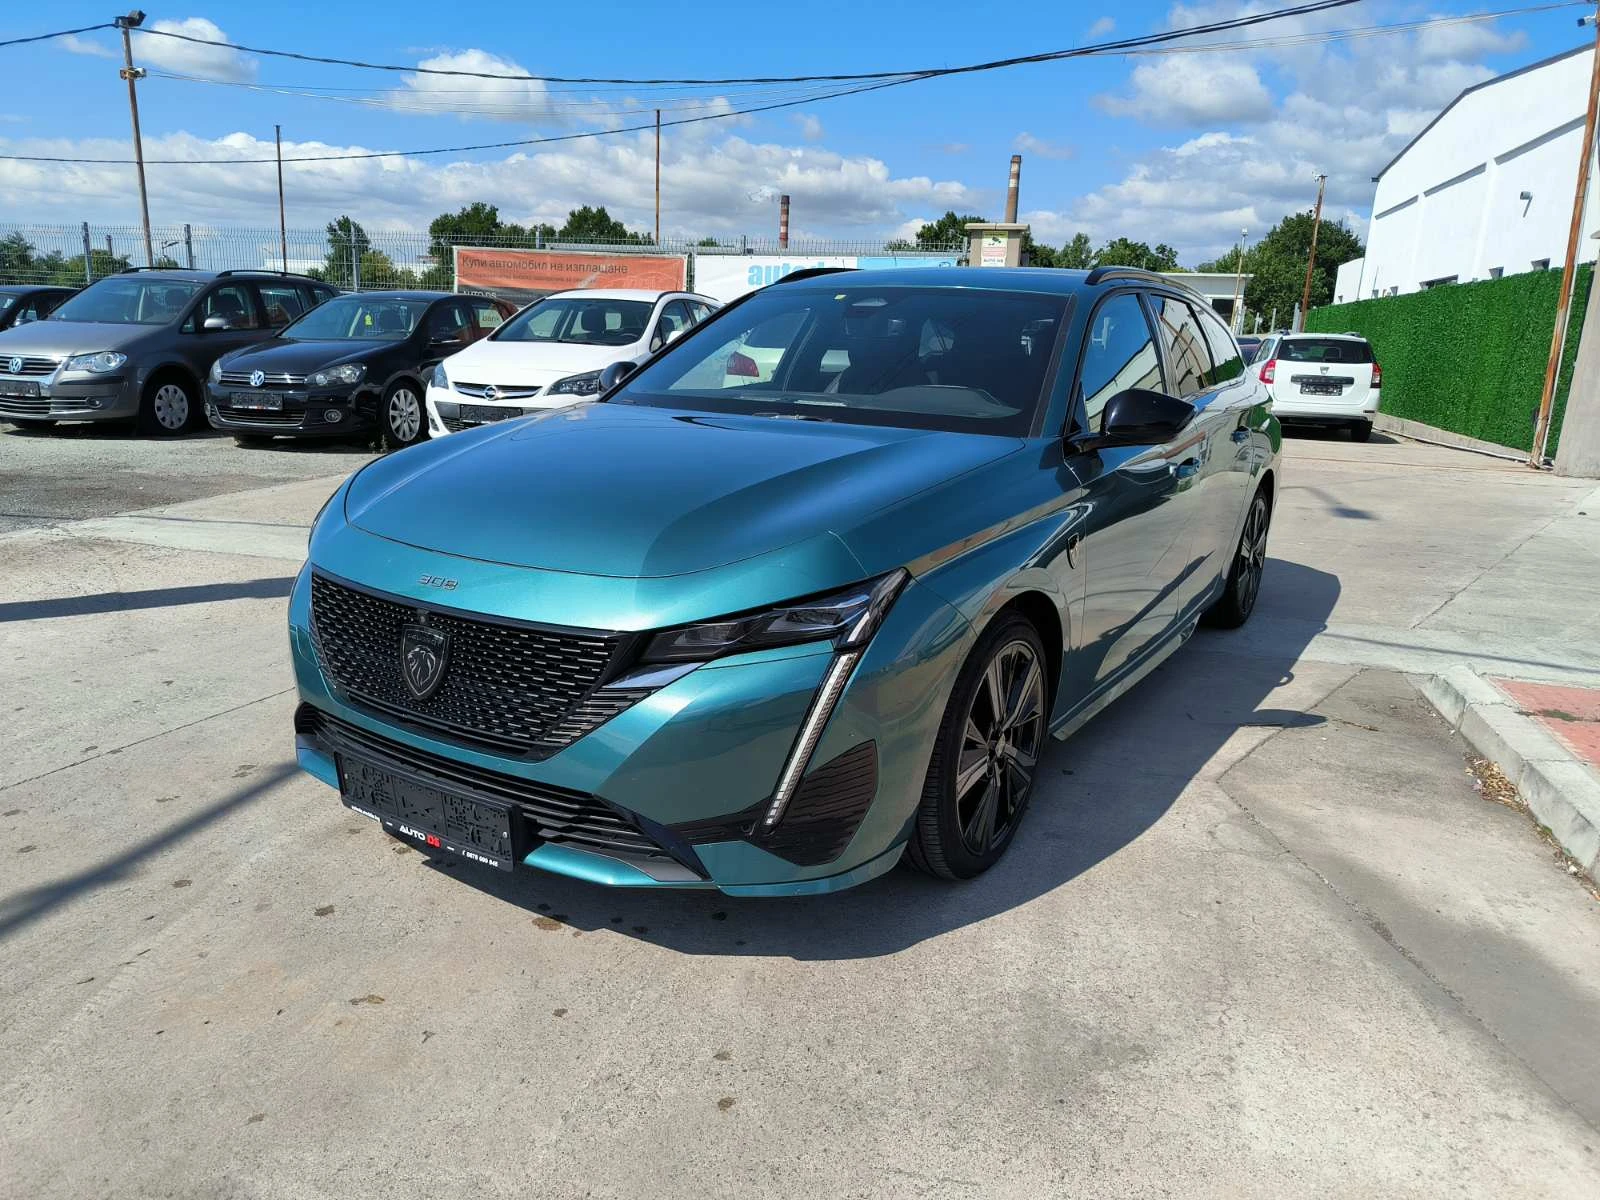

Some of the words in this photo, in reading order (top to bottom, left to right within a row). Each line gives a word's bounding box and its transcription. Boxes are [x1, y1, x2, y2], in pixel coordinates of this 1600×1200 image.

[462, 257, 487, 271] Купи
[488, 259, 547, 270] автомобил
[550, 263, 563, 271] на
[566, 264, 628, 275] изплащане
[418, 574, 459, 590] 308
[399, 825, 426, 841] AUTO
